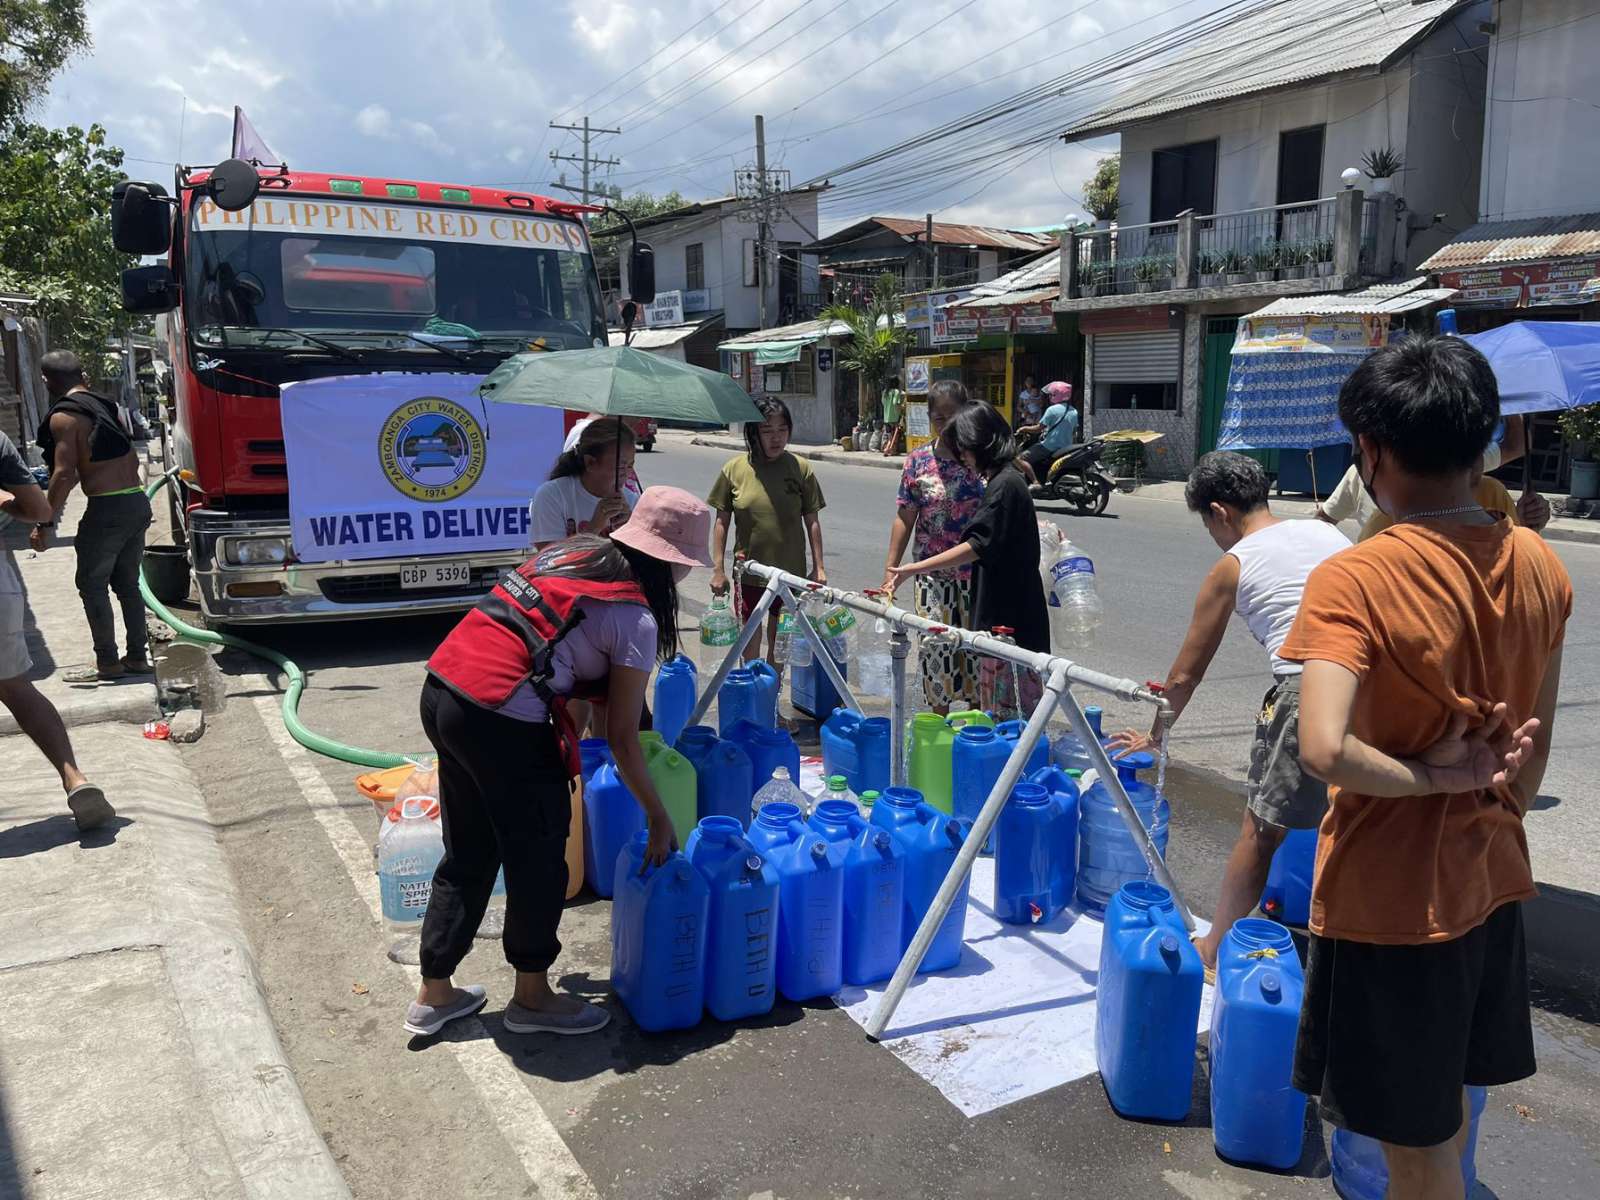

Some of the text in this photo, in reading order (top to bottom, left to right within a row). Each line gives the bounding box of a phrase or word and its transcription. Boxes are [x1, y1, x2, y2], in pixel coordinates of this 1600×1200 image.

[199, 201, 582, 247] PHILIPPINE RED CROSS
[384, 402, 481, 483] ZAMBOANGA CITY WATER DISTRICT
[424, 489, 447, 498] 1974
[309, 511, 414, 547] WATER
[403, 567, 468, 584] CBP 5396
[399, 881, 432, 891] NATU
